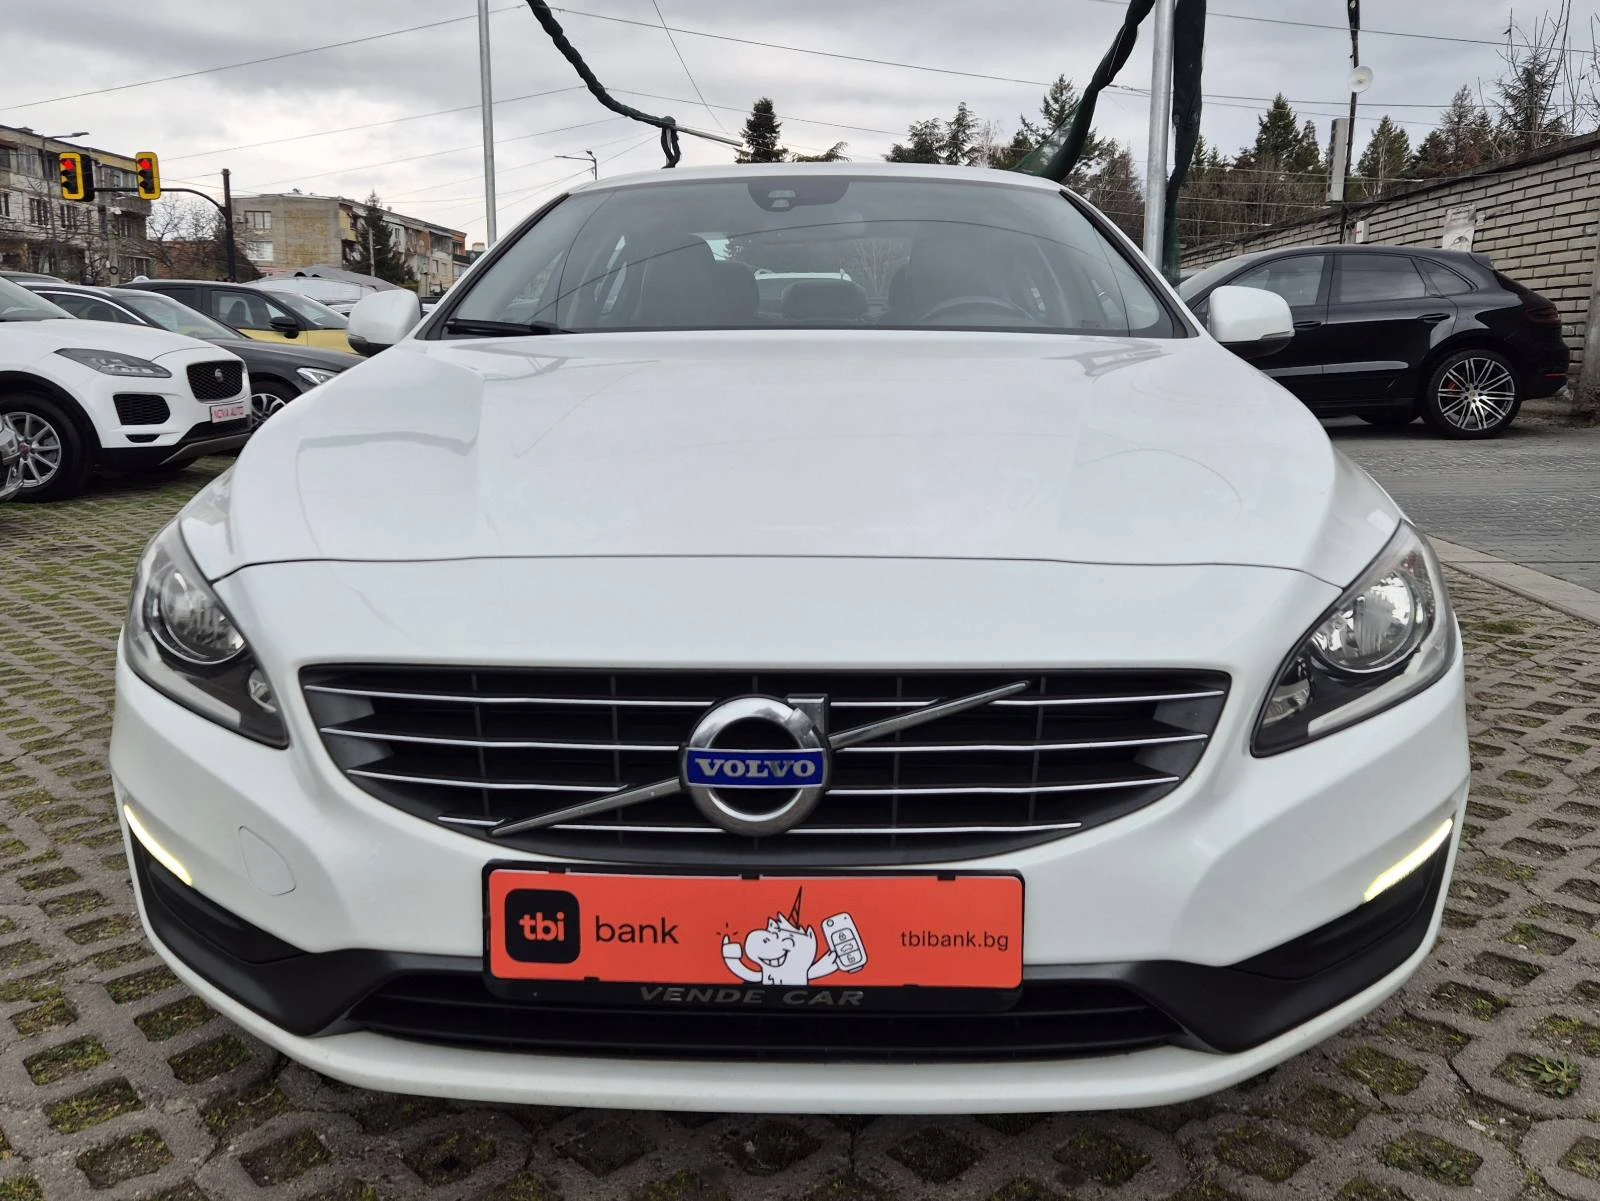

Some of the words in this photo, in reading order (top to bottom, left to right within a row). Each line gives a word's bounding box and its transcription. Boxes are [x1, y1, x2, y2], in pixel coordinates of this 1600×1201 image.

[694, 758, 816, 778] VOLVO
[519, 912, 565, 942] tbi
[595, 915, 680, 944] bank
[900, 930, 1009, 952] tbibank.bg
[639, 986, 765, 1004] VENDE
[782, 989, 864, 1006] CAR
